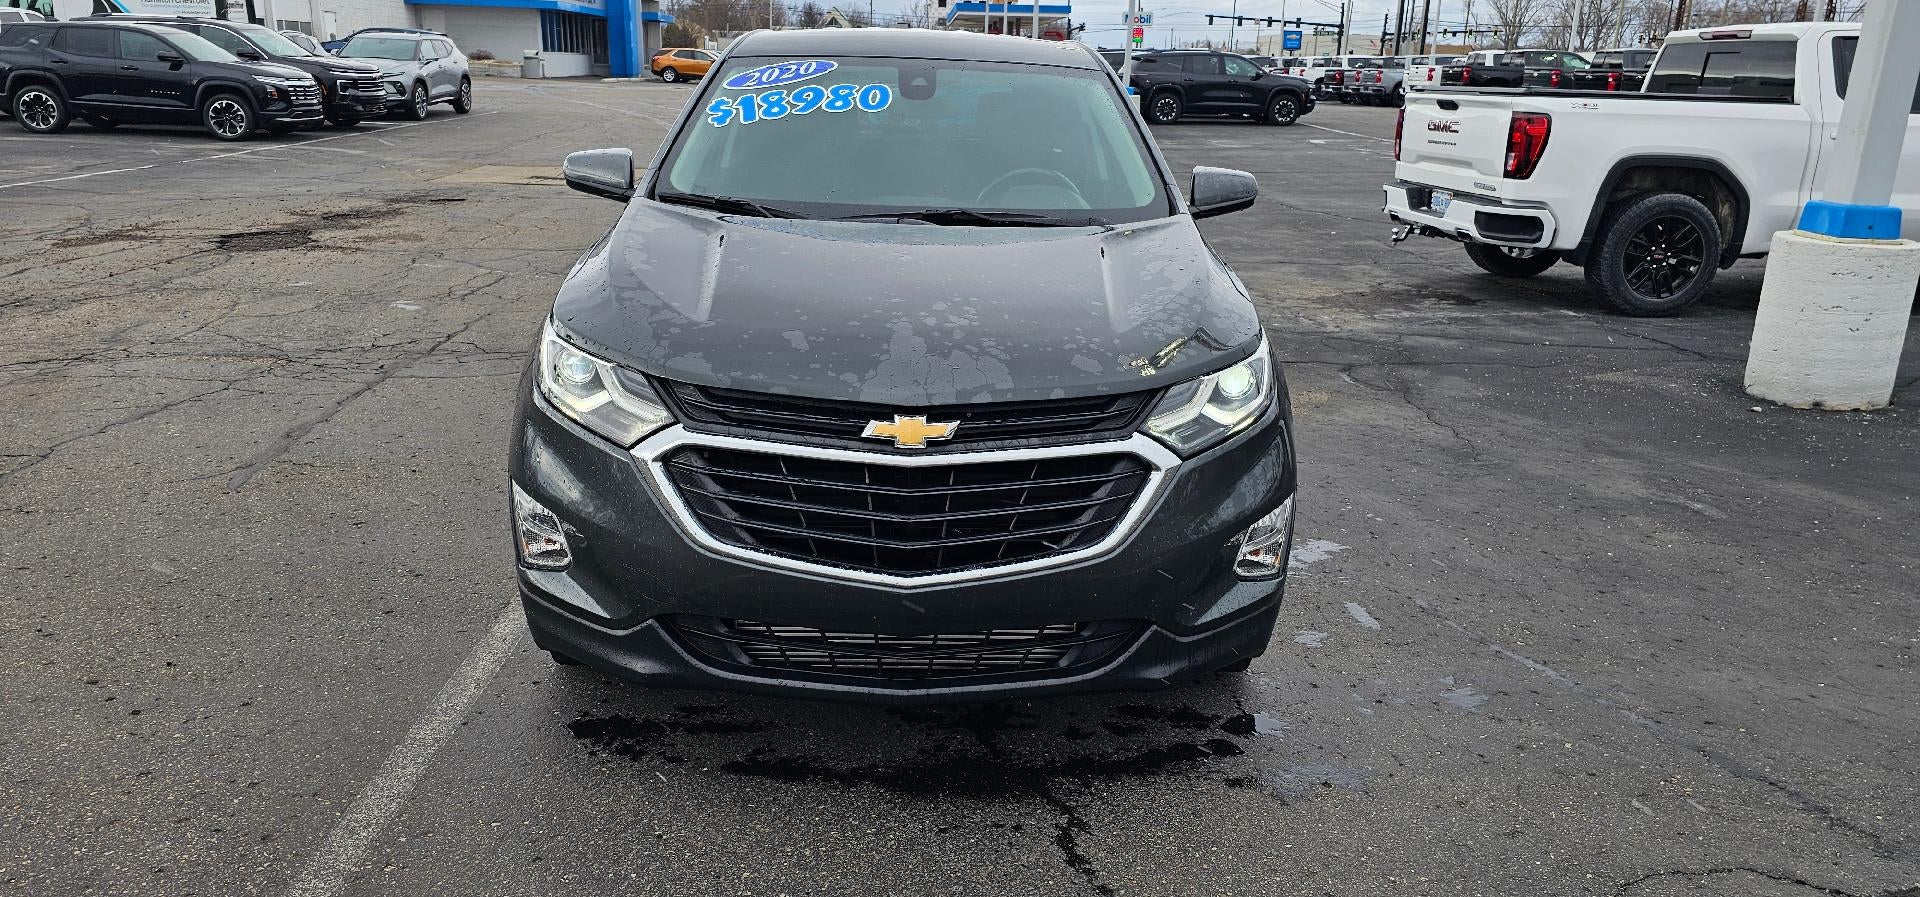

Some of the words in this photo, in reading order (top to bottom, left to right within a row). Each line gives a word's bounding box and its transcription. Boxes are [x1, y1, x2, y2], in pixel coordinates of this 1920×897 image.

[742, 61, 817, 87] 2020
[706, 84, 892, 128] $18980
[1427, 120, 1460, 134] GMC
